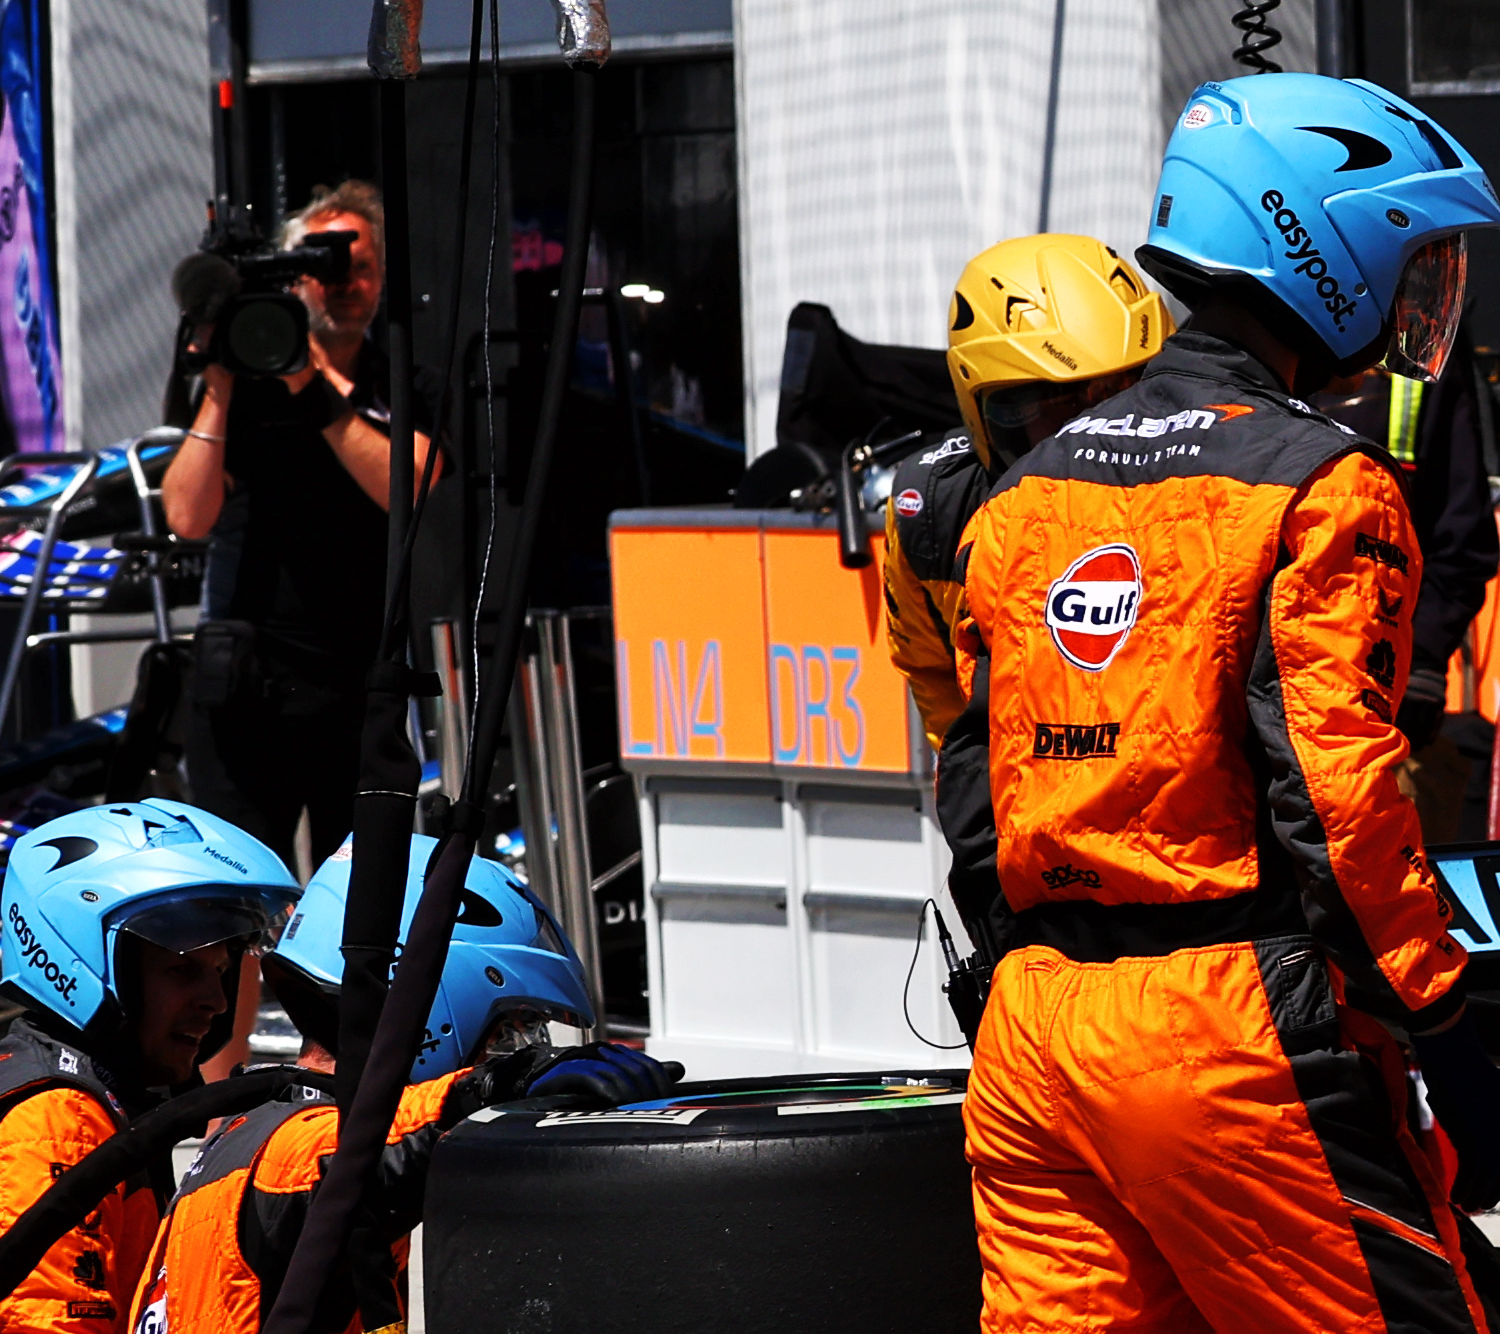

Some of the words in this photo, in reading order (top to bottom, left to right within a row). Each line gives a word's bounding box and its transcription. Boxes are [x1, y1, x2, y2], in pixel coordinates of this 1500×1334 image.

[1187, 110, 1207, 124] BELL
[1260, 188, 1357, 334] easypost.
[1042, 340, 1079, 372] Medallia
[1055, 407, 1218, 439] McLaren
[1051, 588, 1137, 626] Gulf
[618, 640, 726, 758] LN4
[771, 643, 864, 768] DR3
[1033, 722, 1121, 760] DEWALT
[202, 845, 249, 876] Medallia
[8, 901, 77, 1008] easypost.
